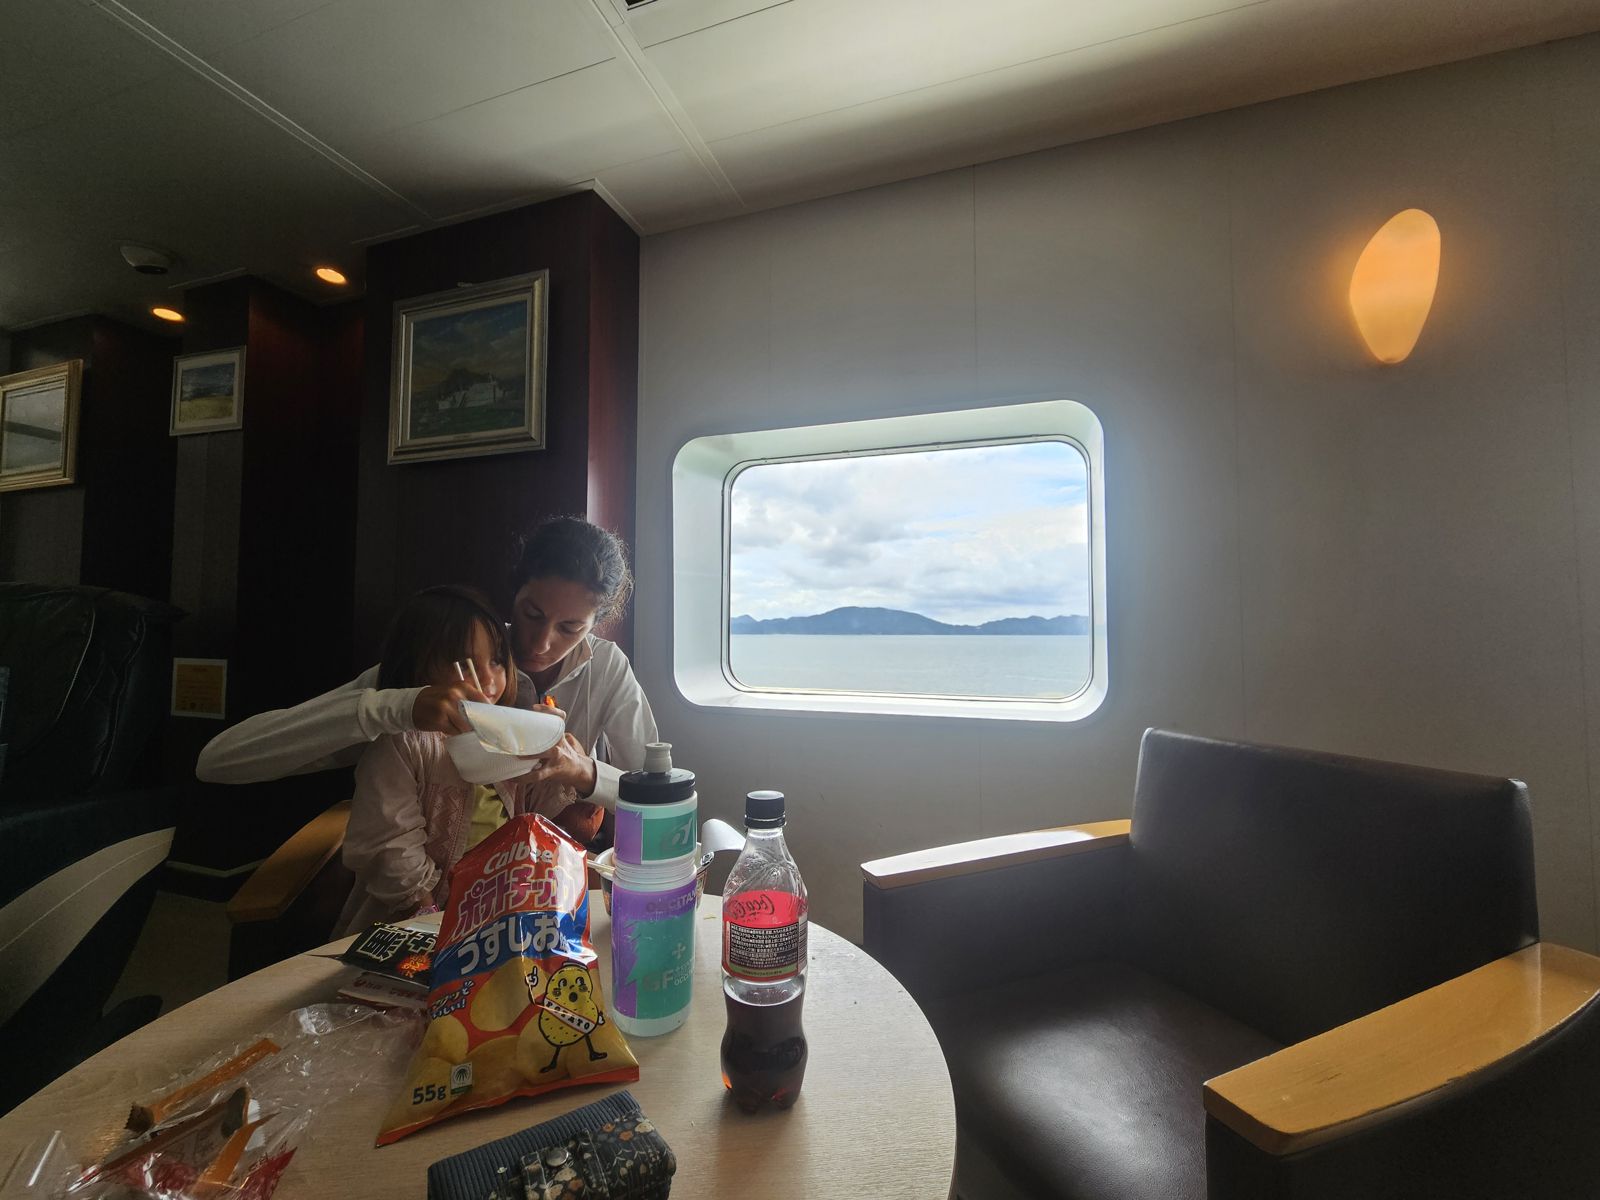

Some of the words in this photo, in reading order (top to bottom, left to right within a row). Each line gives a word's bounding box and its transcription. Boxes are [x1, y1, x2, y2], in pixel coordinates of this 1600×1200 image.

[452, 863, 576, 941] ポテトチッ
[545, 1000, 590, 1031] POTATO
[412, 1083, 446, 1105] 55g
